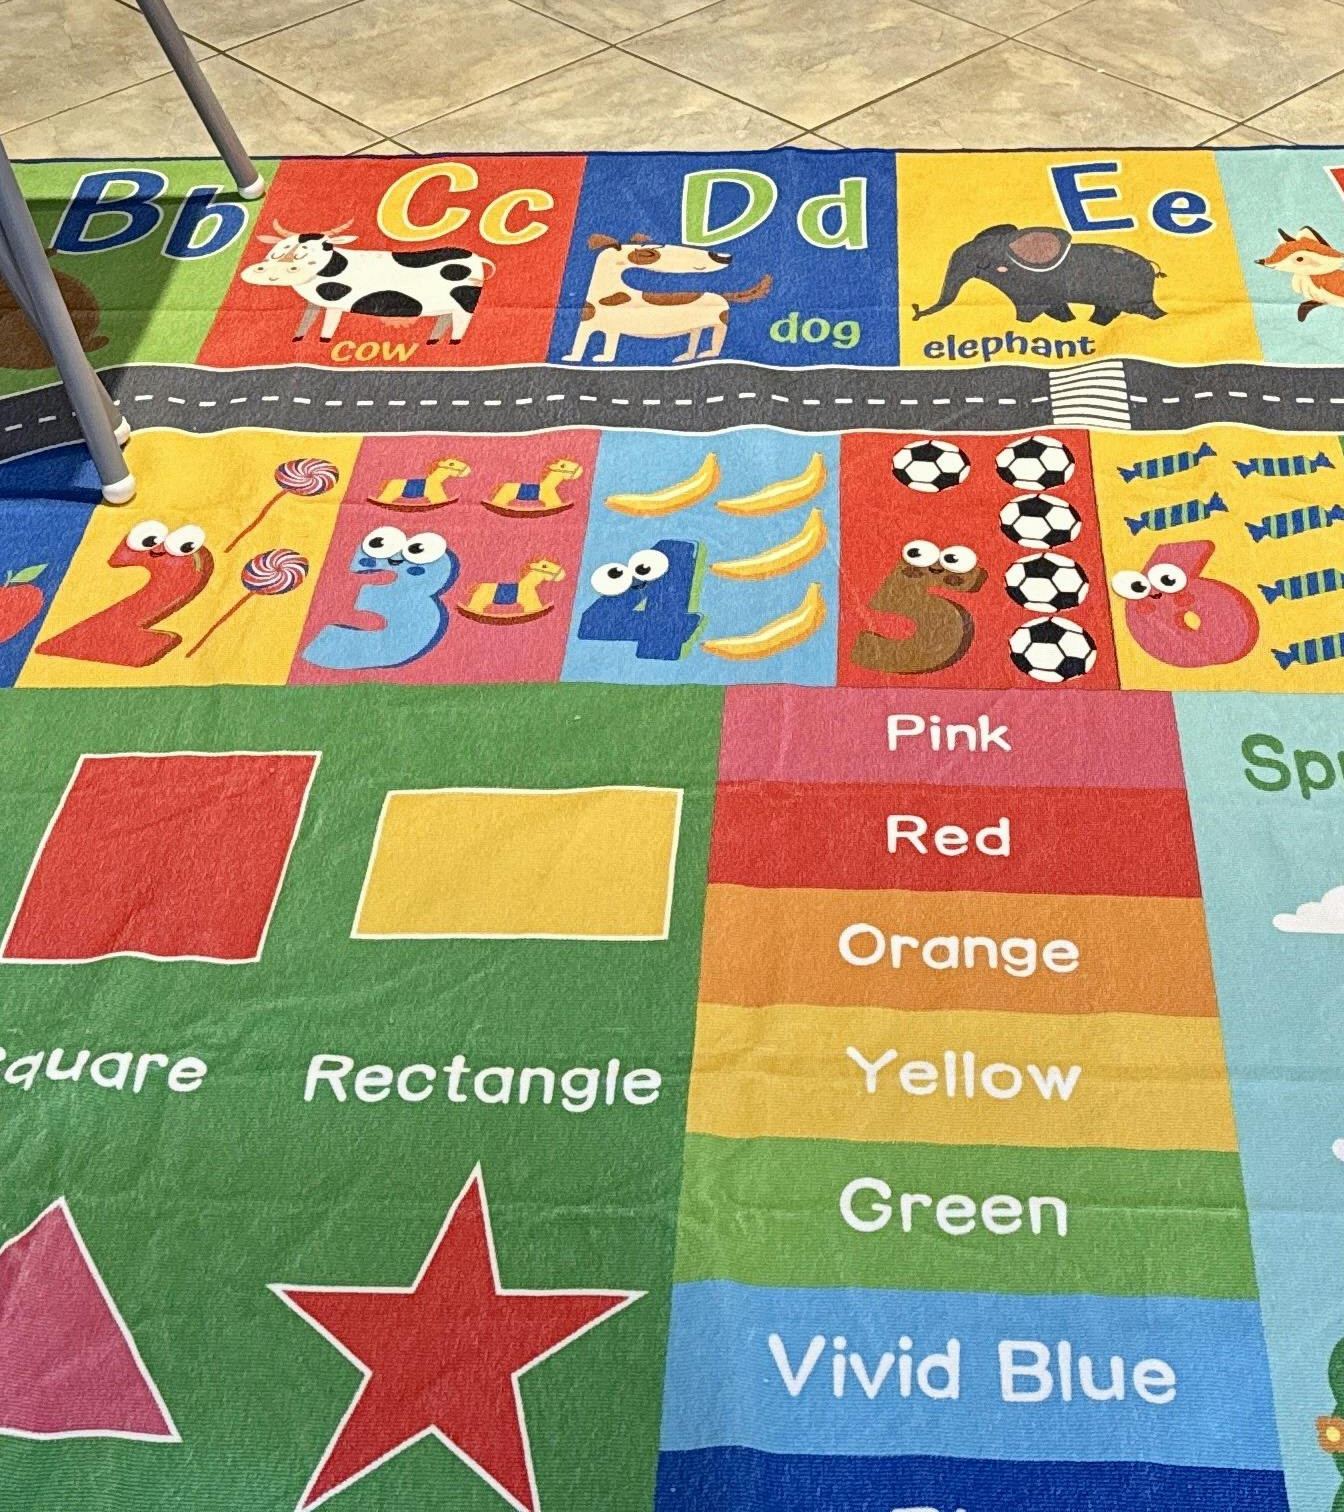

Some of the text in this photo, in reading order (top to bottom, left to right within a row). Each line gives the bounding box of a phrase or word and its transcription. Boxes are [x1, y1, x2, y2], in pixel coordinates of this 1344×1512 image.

[54, 169, 251, 261] Bb
[376, 160, 554, 246] Cc
[682, 168, 869, 250] Dd
[1047, 159, 1217, 237] Ee
[330, 339, 420, 364] cow
[770, 310, 860, 348] dog
[923, 330, 1097, 362] elephant
[886, 714, 1013, 754] Pink
[886, 814, 1013, 858] Red
[837, 922, 1081, 977] Orange
[304, 1054, 663, 1113] Rectangle
[846, 1046, 1083, 1102] Yellow
[839, 1177, 1069, 1236] Green
[768, 1332, 1179, 1404] Vivid Blue
